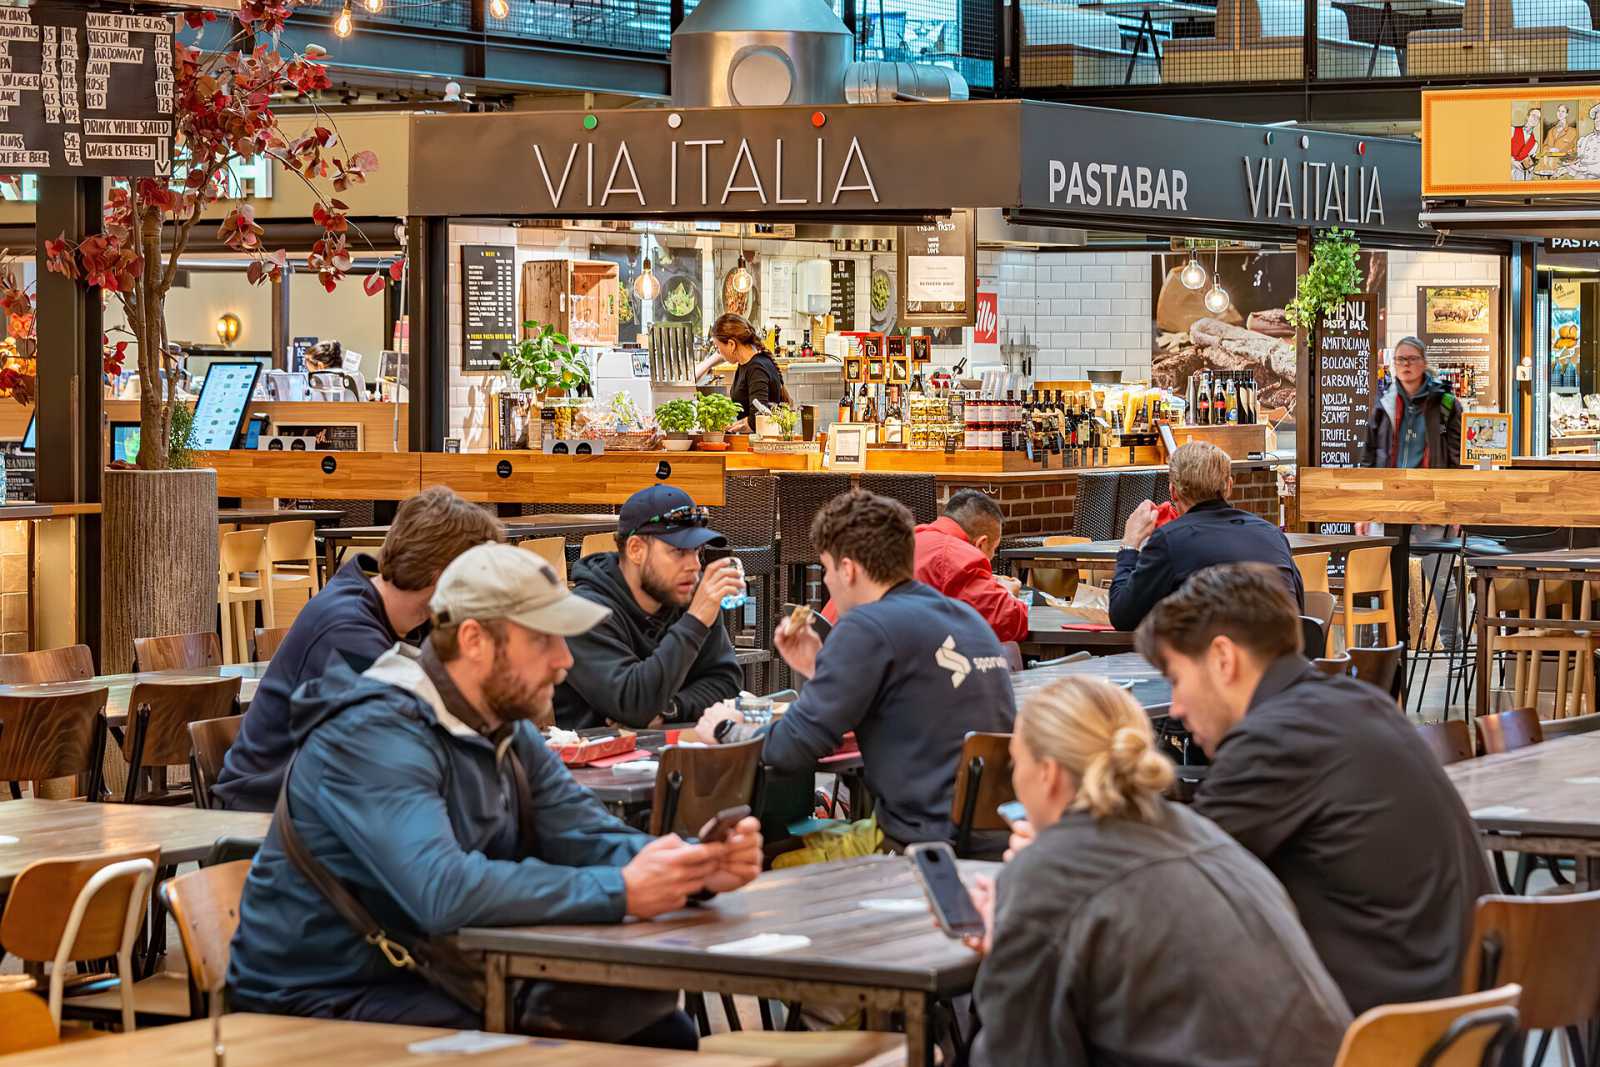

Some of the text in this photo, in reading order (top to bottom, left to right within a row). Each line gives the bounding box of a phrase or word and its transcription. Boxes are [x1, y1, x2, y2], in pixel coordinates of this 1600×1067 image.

[87, 15, 166, 31] WINE BY THE GLASS
[87, 30, 128, 45] RIESLING
[90, 48, 142, 63] HARDONNAY
[87, 93, 103, 106] RED
[84, 119, 169, 134] DRINK WHILE SEATED
[29, 152, 48, 163] BEER
[86, 144, 113, 157] WATER
[115, 145, 122, 156] IS
[533, 136, 880, 208] VIA ITALIA
[1049, 160, 1188, 211] PASTABAR
[1244, 155, 1385, 225] VIA ITALIA
[1327, 300, 1366, 320] MENU
[975, 299, 997, 340] illy
[1323, 319, 1369, 331] PASTA BAR
[1322, 336, 1370, 350] AMATRICIANA
[1321, 356, 1369, 370] BOLOGNESE
[1321, 374, 1370, 388] CARBONARA
[1321, 393, 1347, 405] NDUJA
[1320, 412, 1350, 424] SCAMPI
[1320, 429, 1351, 441] TRUFFLE
[1321, 451, 1350, 463] PORCINI
[1320, 522, 1351, 535] GNOCCHI
